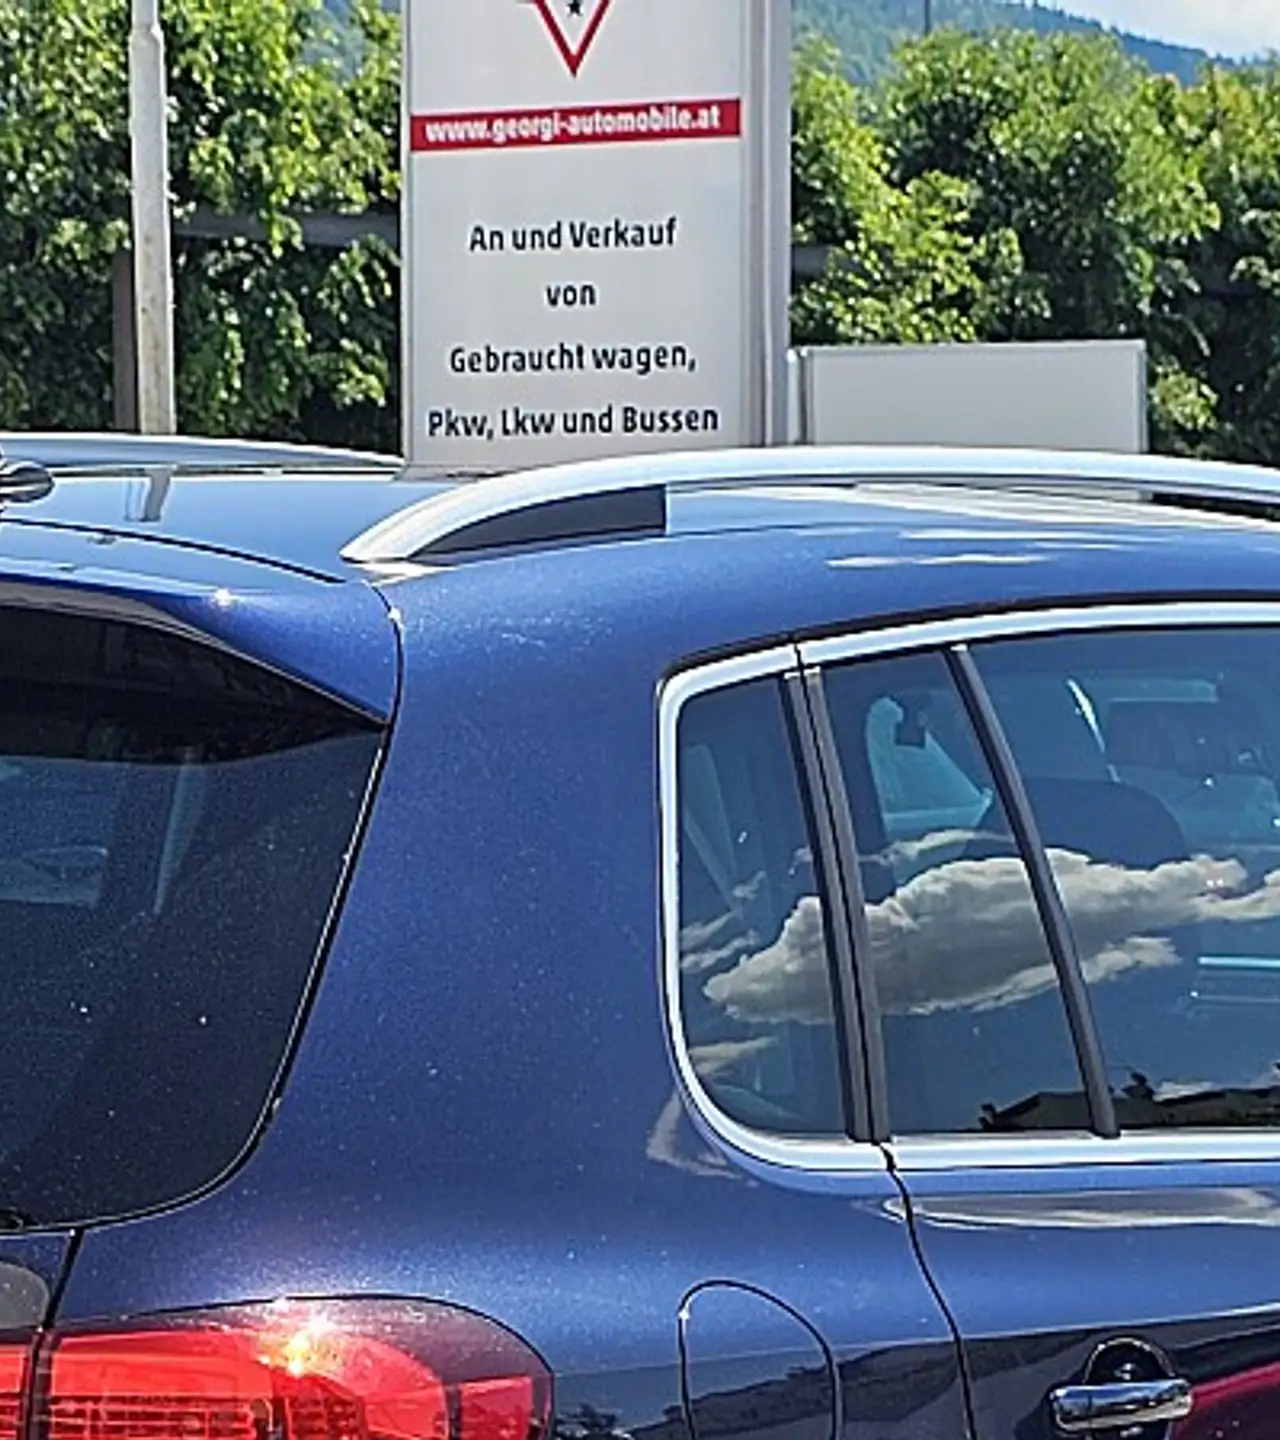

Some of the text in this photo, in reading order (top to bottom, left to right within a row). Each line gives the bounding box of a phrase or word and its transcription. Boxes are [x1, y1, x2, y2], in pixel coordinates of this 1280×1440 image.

[425, 105, 720, 143] www.georgi-automobile.at
[469, 216, 677, 252] An und Verkauf
[547, 282, 596, 307] von
[450, 344, 696, 376] Gebraucht wagen,
[428, 404, 719, 441] Pkw, Lkw und Bussen
